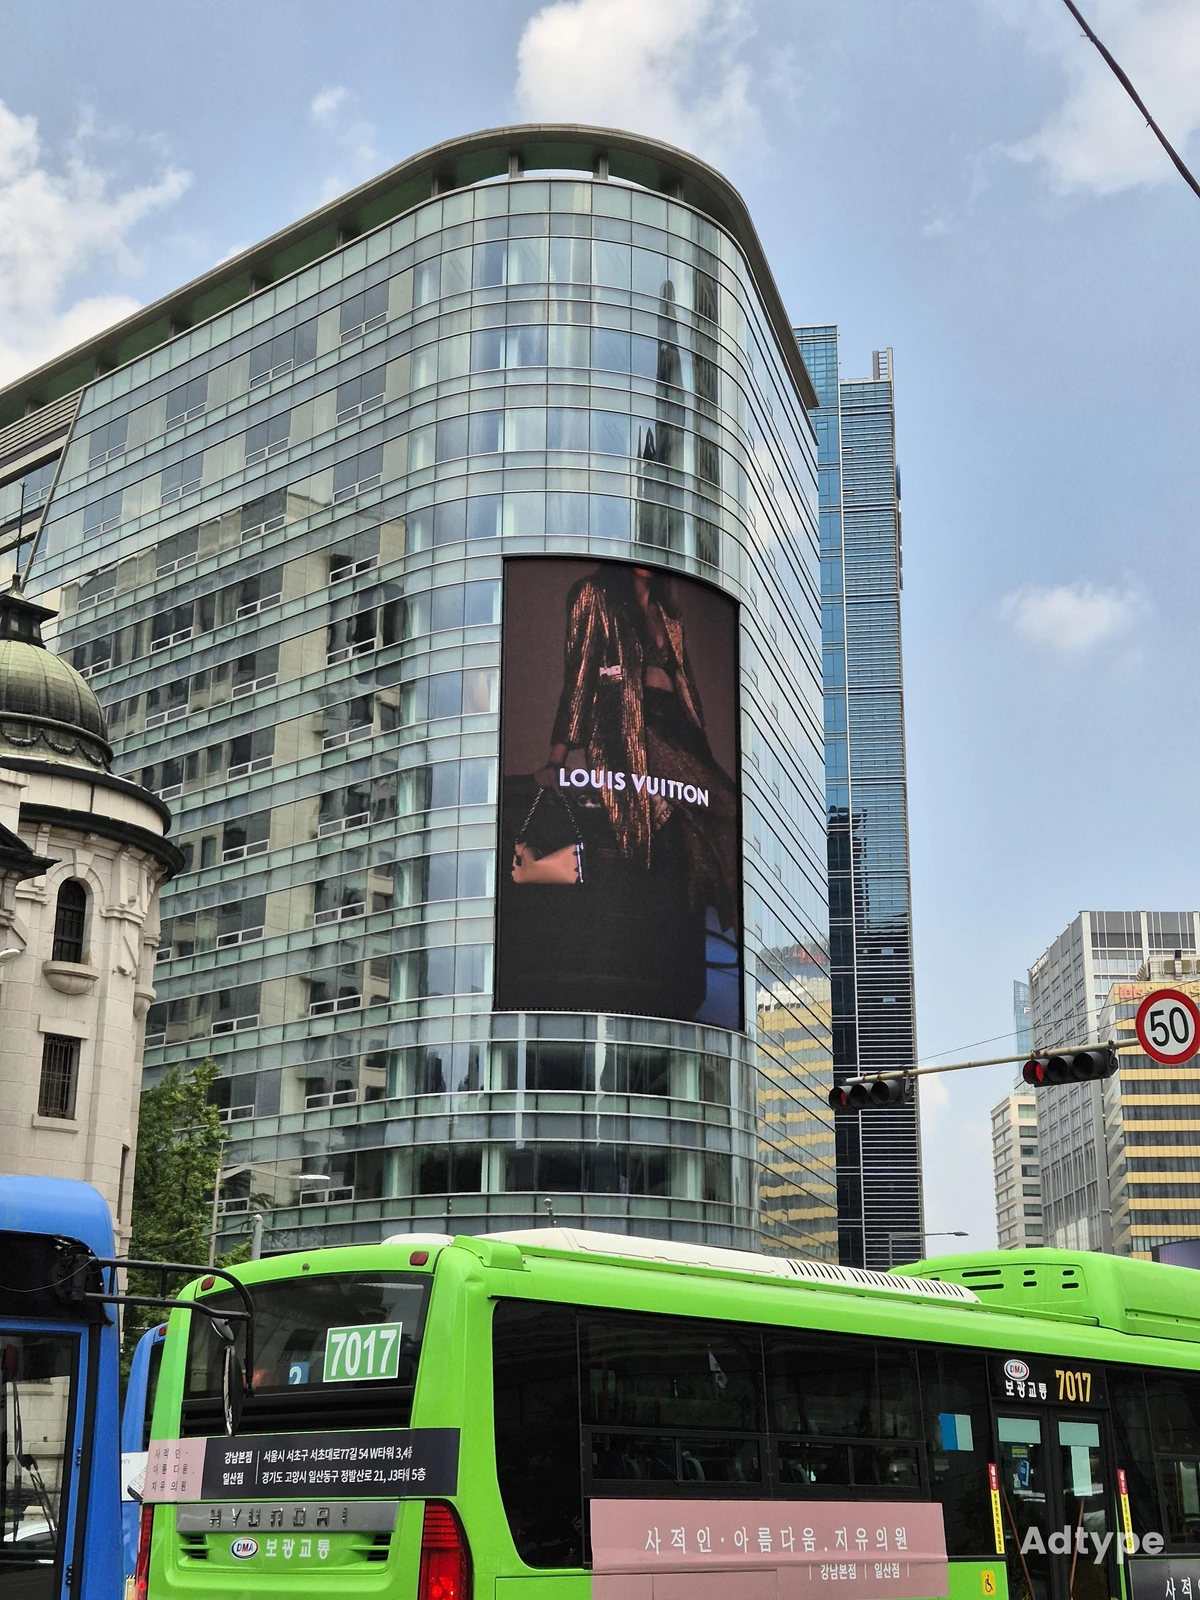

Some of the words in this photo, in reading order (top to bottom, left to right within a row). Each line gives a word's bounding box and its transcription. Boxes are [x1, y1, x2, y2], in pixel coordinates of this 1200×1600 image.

[559, 767, 626, 791] LOUIS
[631, 773, 709, 807] VUITTON
[1150, 1006, 1190, 1047] 50
[330, 1329, 397, 1377] 7017
[1005, 1380, 1047, 1400] 보광교통
[1055, 1369, 1091, 1402] 7017
[224, 1450, 253, 1464] 강남본점
[263, 1449, 286, 1463] 서울시
[286, 1449, 309, 1462] 서초구
[310, 1447, 358, 1462] 서초대로77길
[358, 1447, 369, 1460] 54
[370, 1446, 395, 1460] W타워
[152, 1480, 187, 1492] 지유의원
[222, 1471, 244, 1485] 일산점
[261, 1471, 283, 1484] 경기도
[284, 1470, 307, 1484] 고양시
[308, 1469, 339, 1483] 일산동구
[340, 1468, 372, 1483] 정발산로
[411, 1467, 426, 1482] 5층
[209, 1507, 348, 1528] HYUNDAI
[265, 1538, 330, 1560] 보광교통
[820, 1563, 857, 1581] 강남본점
[874, 1562, 900, 1580] 일산점
[1165, 1576, 1200, 1600] 사적
